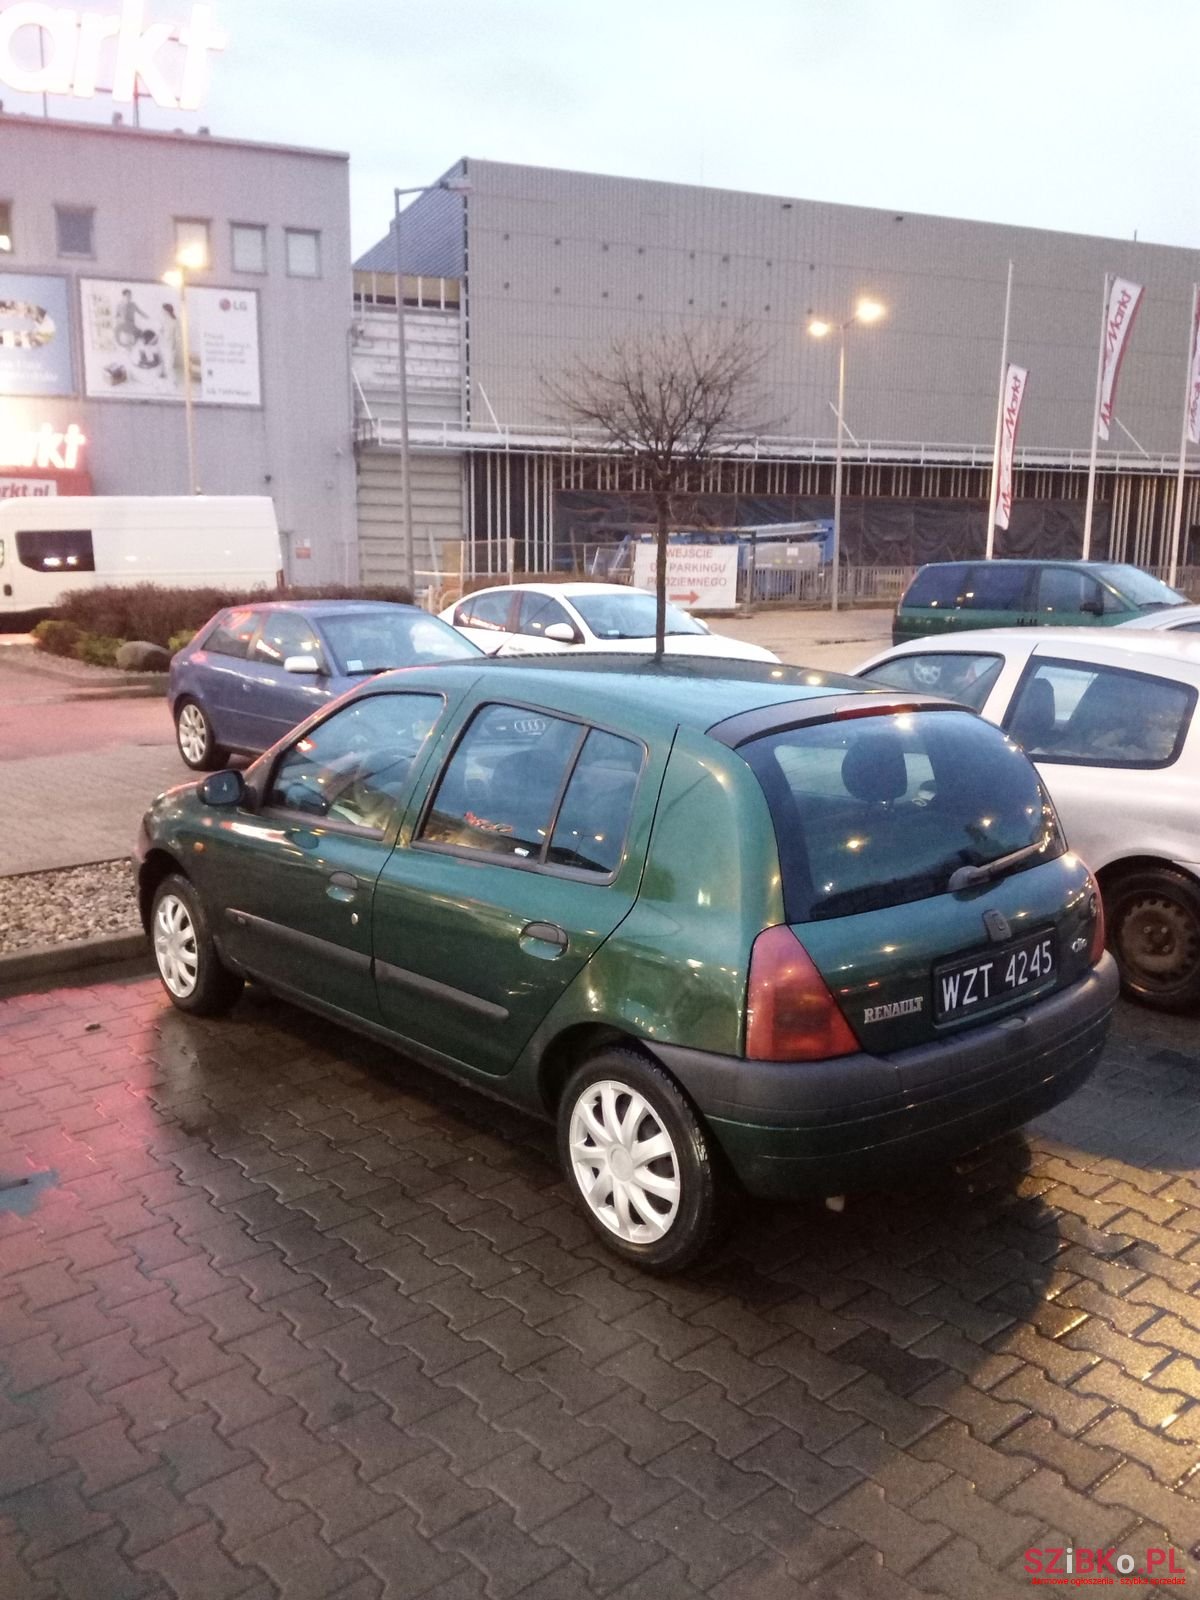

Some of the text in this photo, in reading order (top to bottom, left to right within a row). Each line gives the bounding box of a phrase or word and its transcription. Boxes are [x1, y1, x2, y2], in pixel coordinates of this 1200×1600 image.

[232, 302, 247, 311] LG
[1107, 289, 1132, 352] Markt
[1005, 375, 1021, 438] Markt
[647, 577, 727, 587] PDZIEMNEGO
[669, 563, 727, 573] PARKINGU
[942, 940, 1052, 1011] WZT 4245
[864, 996, 923, 1024] RENAULT
